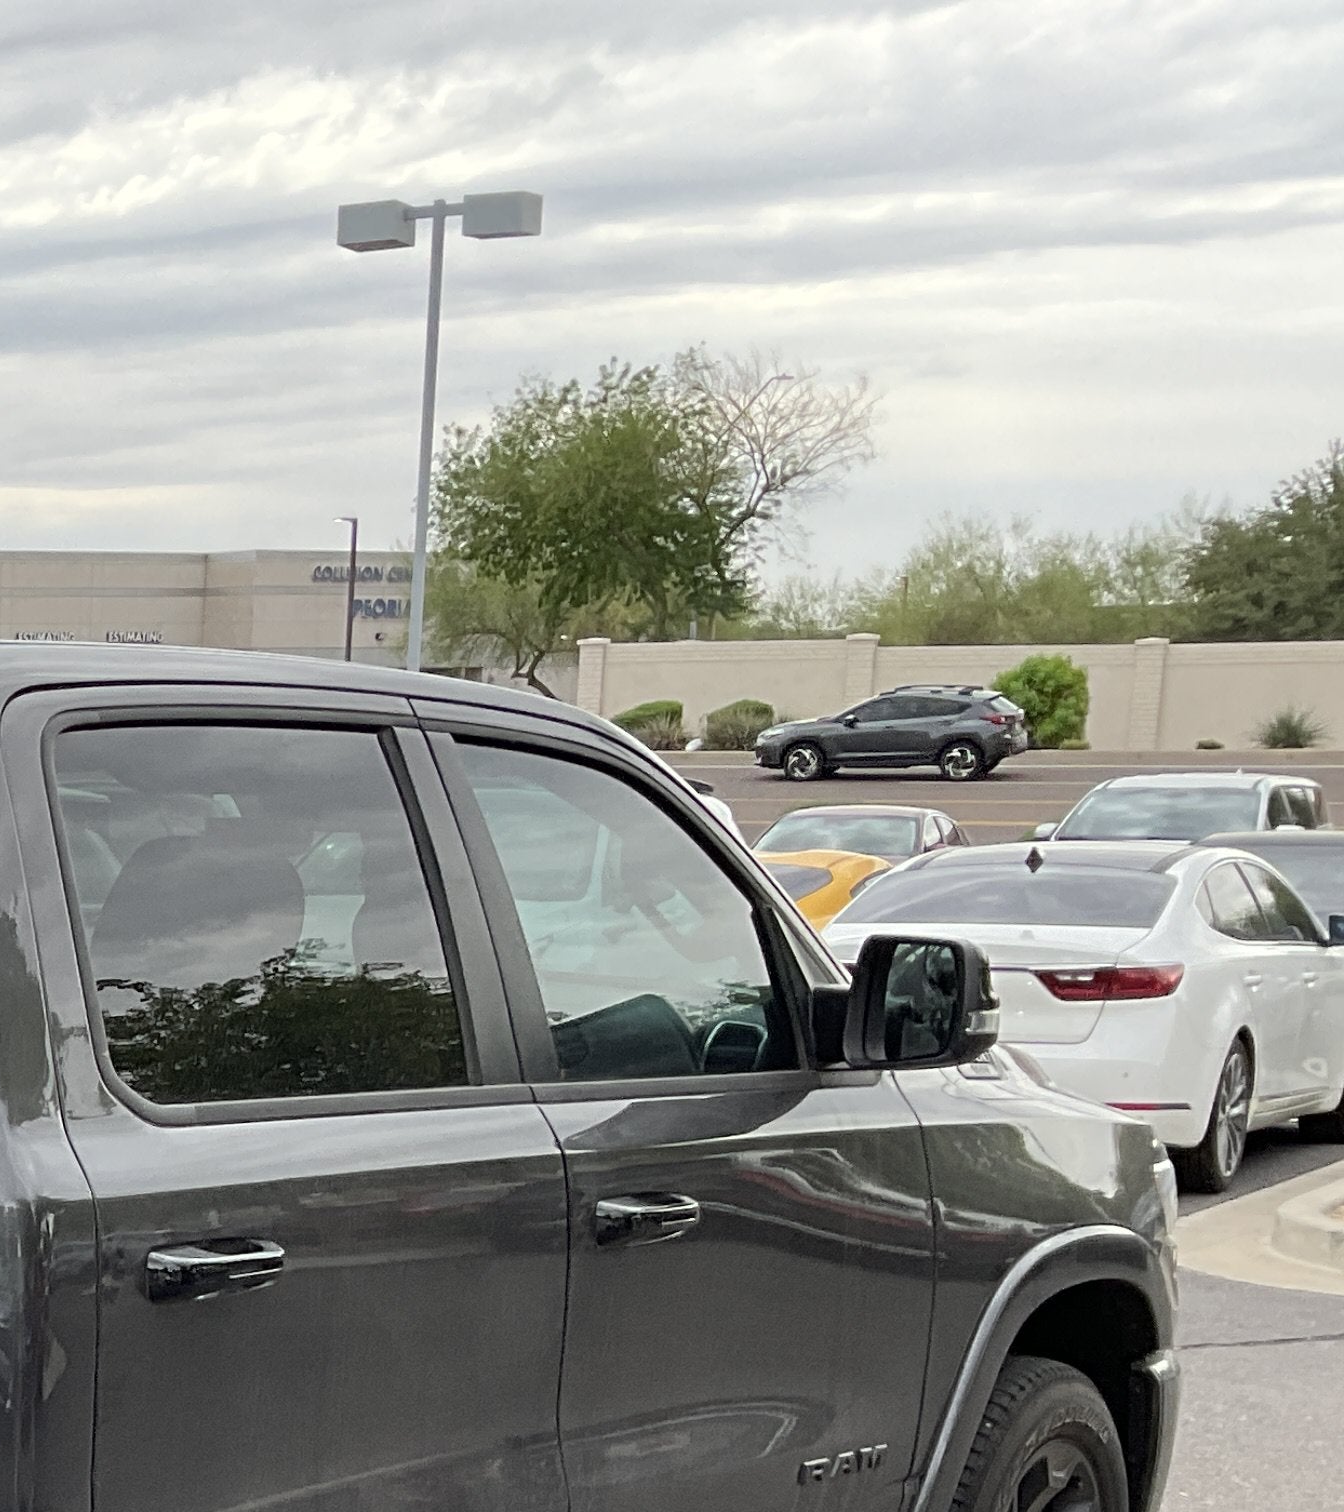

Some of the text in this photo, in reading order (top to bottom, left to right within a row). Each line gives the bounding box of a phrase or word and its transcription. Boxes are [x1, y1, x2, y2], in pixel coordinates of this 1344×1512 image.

[312, 565, 384, 583] COLLIION
[106, 631, 164, 643] ESTIMATING
[797, 1443, 888, 1486] RAM
